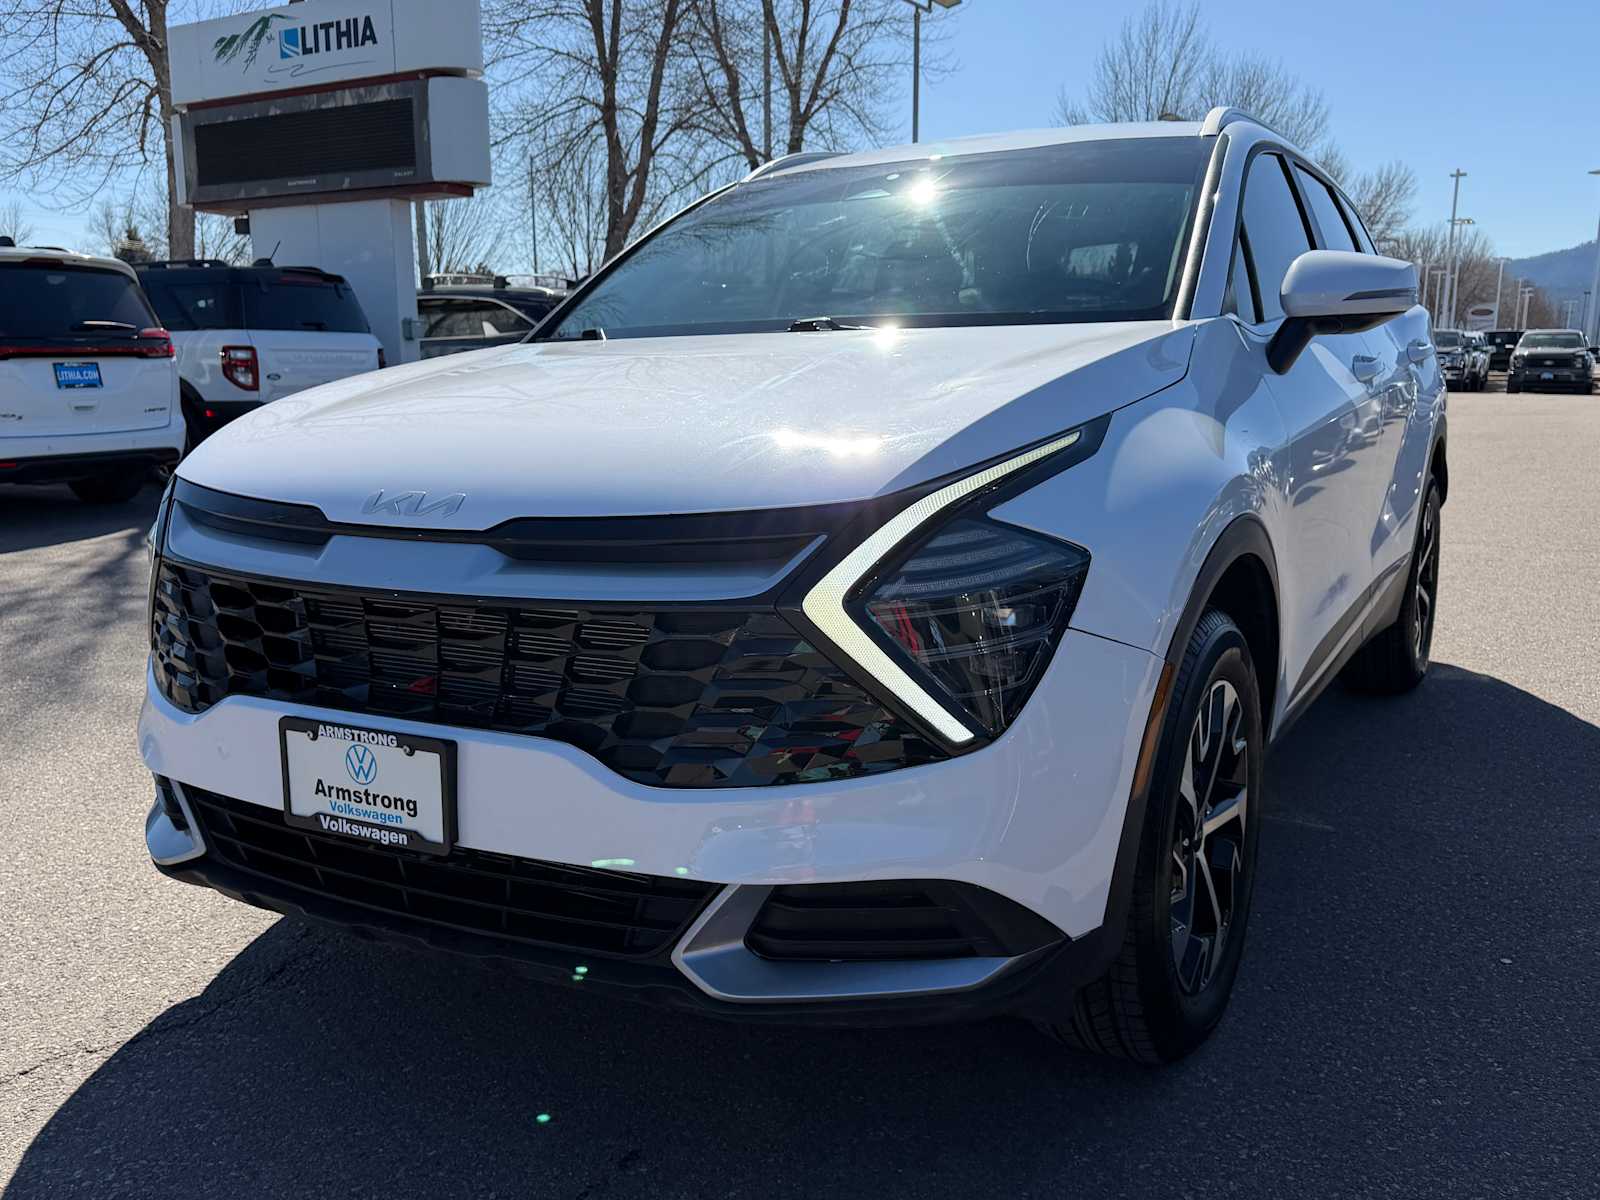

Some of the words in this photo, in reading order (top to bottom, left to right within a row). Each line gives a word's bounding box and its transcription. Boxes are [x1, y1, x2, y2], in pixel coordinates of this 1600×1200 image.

[300, 16, 377, 55] LITHIA
[362, 489, 466, 518] KIA
[318, 725, 398, 747] ARMSTRONG
[315, 779, 418, 817] Armstrong
[329, 801, 403, 824] Volkswagen
[320, 816, 408, 845] Volkswagen
